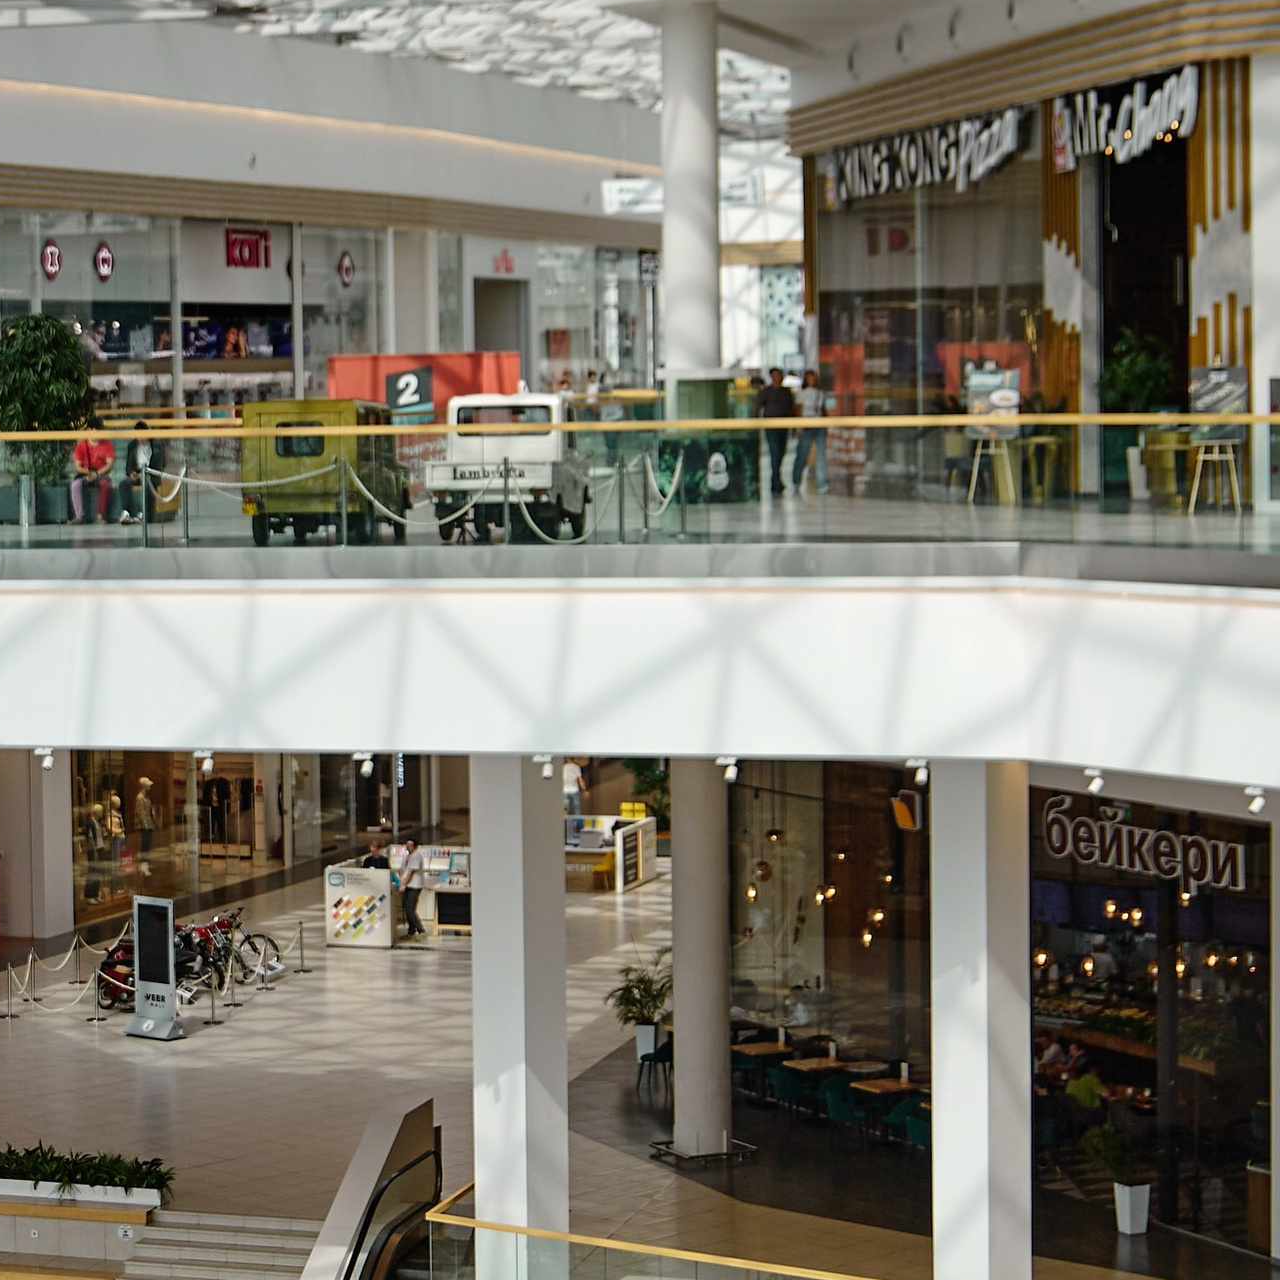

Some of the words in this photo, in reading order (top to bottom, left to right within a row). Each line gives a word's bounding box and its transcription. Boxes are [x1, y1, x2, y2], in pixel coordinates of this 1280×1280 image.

[837, 141, 890, 202] KING
[893, 126, 957, 190] KONG
[396, 373, 421, 406] 2
[1043, 795, 1247, 897] бейкери
